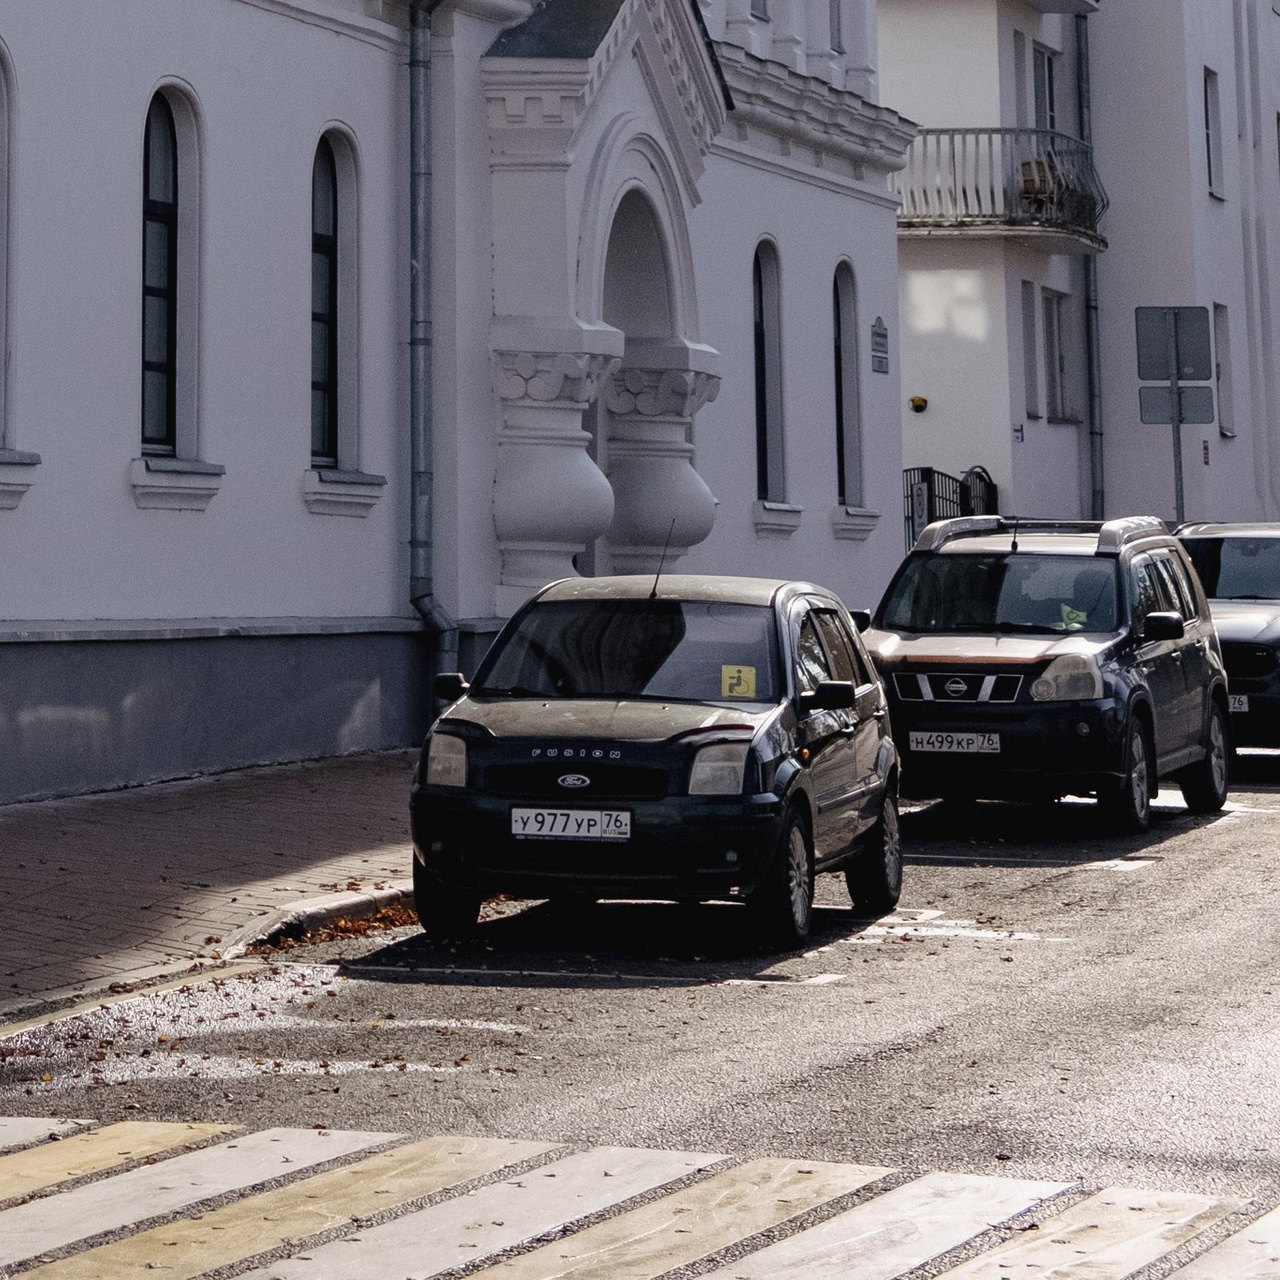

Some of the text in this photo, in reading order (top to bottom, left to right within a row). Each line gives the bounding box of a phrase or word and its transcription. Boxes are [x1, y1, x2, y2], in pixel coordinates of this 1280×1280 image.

[1230, 696, 1244, 706] 76
[979, 734, 995, 746] 76
[531, 748, 621, 759] FUSION
[604, 813, 623, 829] 76
